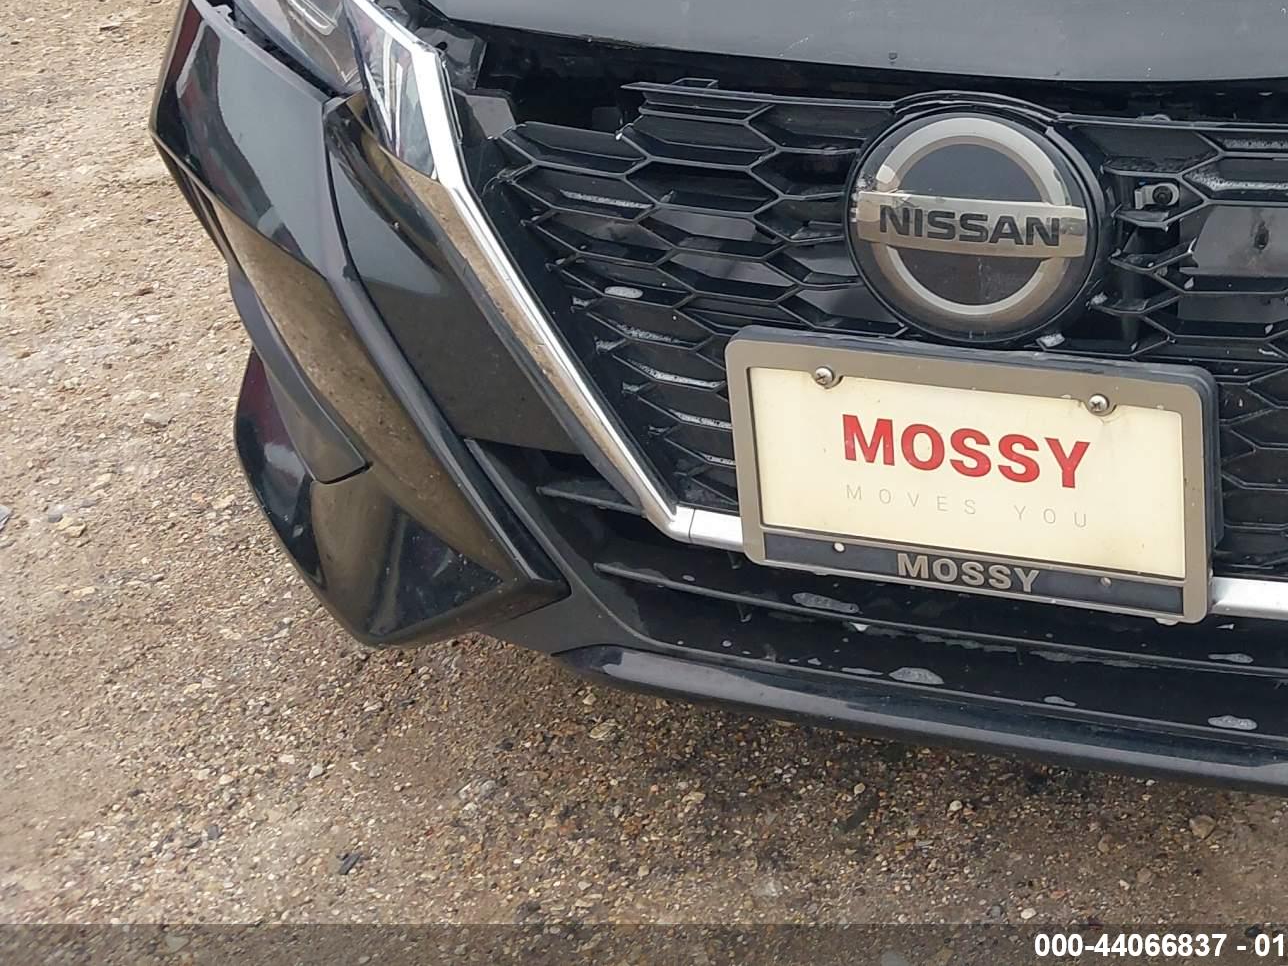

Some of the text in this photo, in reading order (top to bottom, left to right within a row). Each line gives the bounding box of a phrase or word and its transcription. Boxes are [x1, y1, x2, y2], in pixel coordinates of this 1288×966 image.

[879, 204, 1060, 247] NISSAN
[841, 413, 1091, 489] MOSSY
[845, 483, 1088, 529] MOVES YOU
[896, 552, 1040, 594] MOSSY
